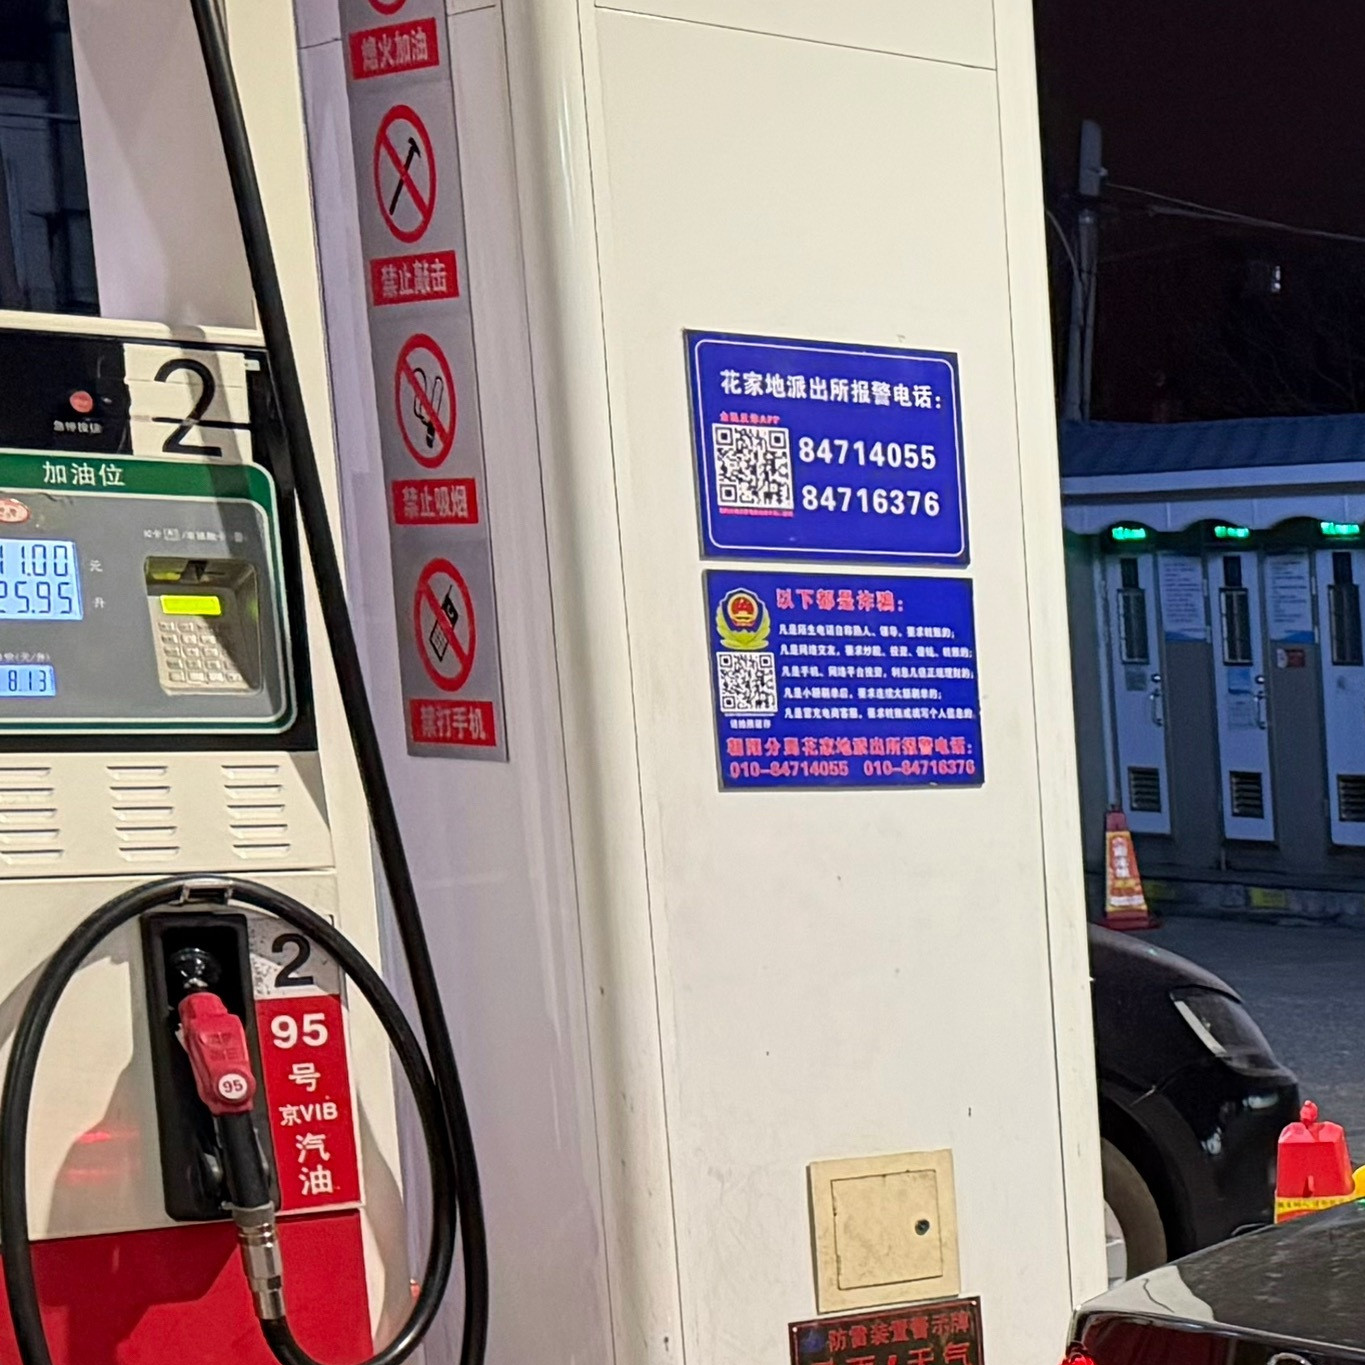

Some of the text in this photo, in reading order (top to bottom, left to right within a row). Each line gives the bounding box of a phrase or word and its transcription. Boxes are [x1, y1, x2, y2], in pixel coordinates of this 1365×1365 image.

[381, 259, 448, 299] 禁止敲击
[720, 370, 941, 409] 花家地派出所报警电话：
[154, 358, 222, 457] 2
[799, 437, 936, 470] 84714055
[43, 462, 126, 488] 加油位
[402, 486, 469, 520] 禁止吸烟
[801, 485, 940, 517] 84716376
[90, 559, 103, 572] 元
[419, 706, 490, 741] 禁打手机
[271, 933, 315, 988] 2
[270, 1013, 328, 1050] 95
[222, 1079, 243, 1093] 95
[289, 1063, 321, 1092] 号
[279, 1103, 338, 1126] 京VIB
[296, 1133, 334, 1195] 汽油
